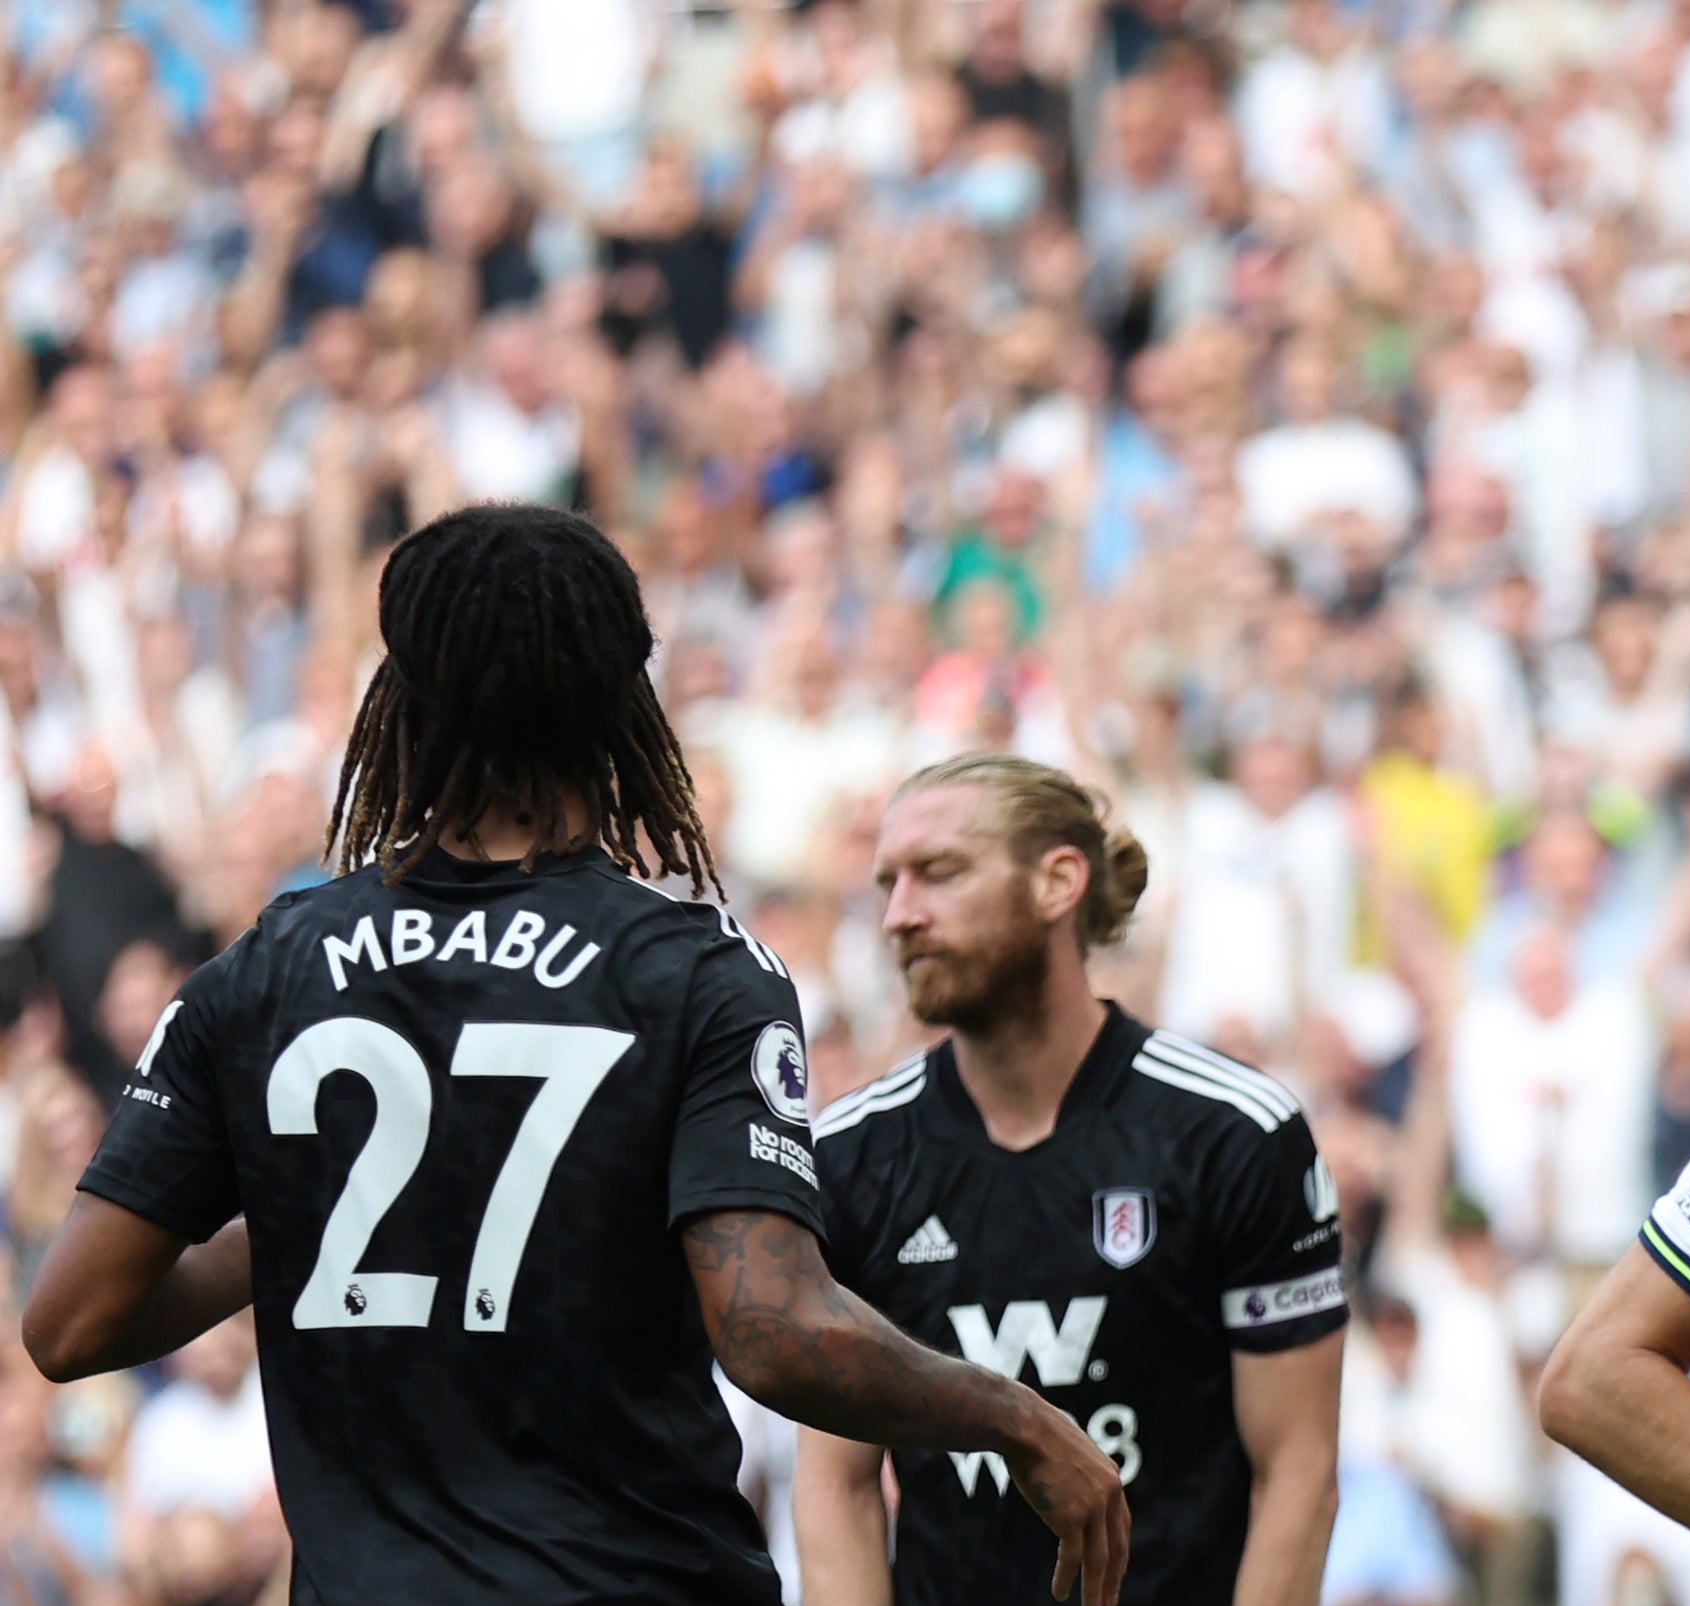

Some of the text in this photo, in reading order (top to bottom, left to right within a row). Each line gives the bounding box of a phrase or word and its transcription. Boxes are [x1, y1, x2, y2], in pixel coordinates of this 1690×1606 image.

[322, 908, 602, 993] MBABU
[266, 1016, 637, 1333] 27
[750, 1123, 815, 1171] No room
